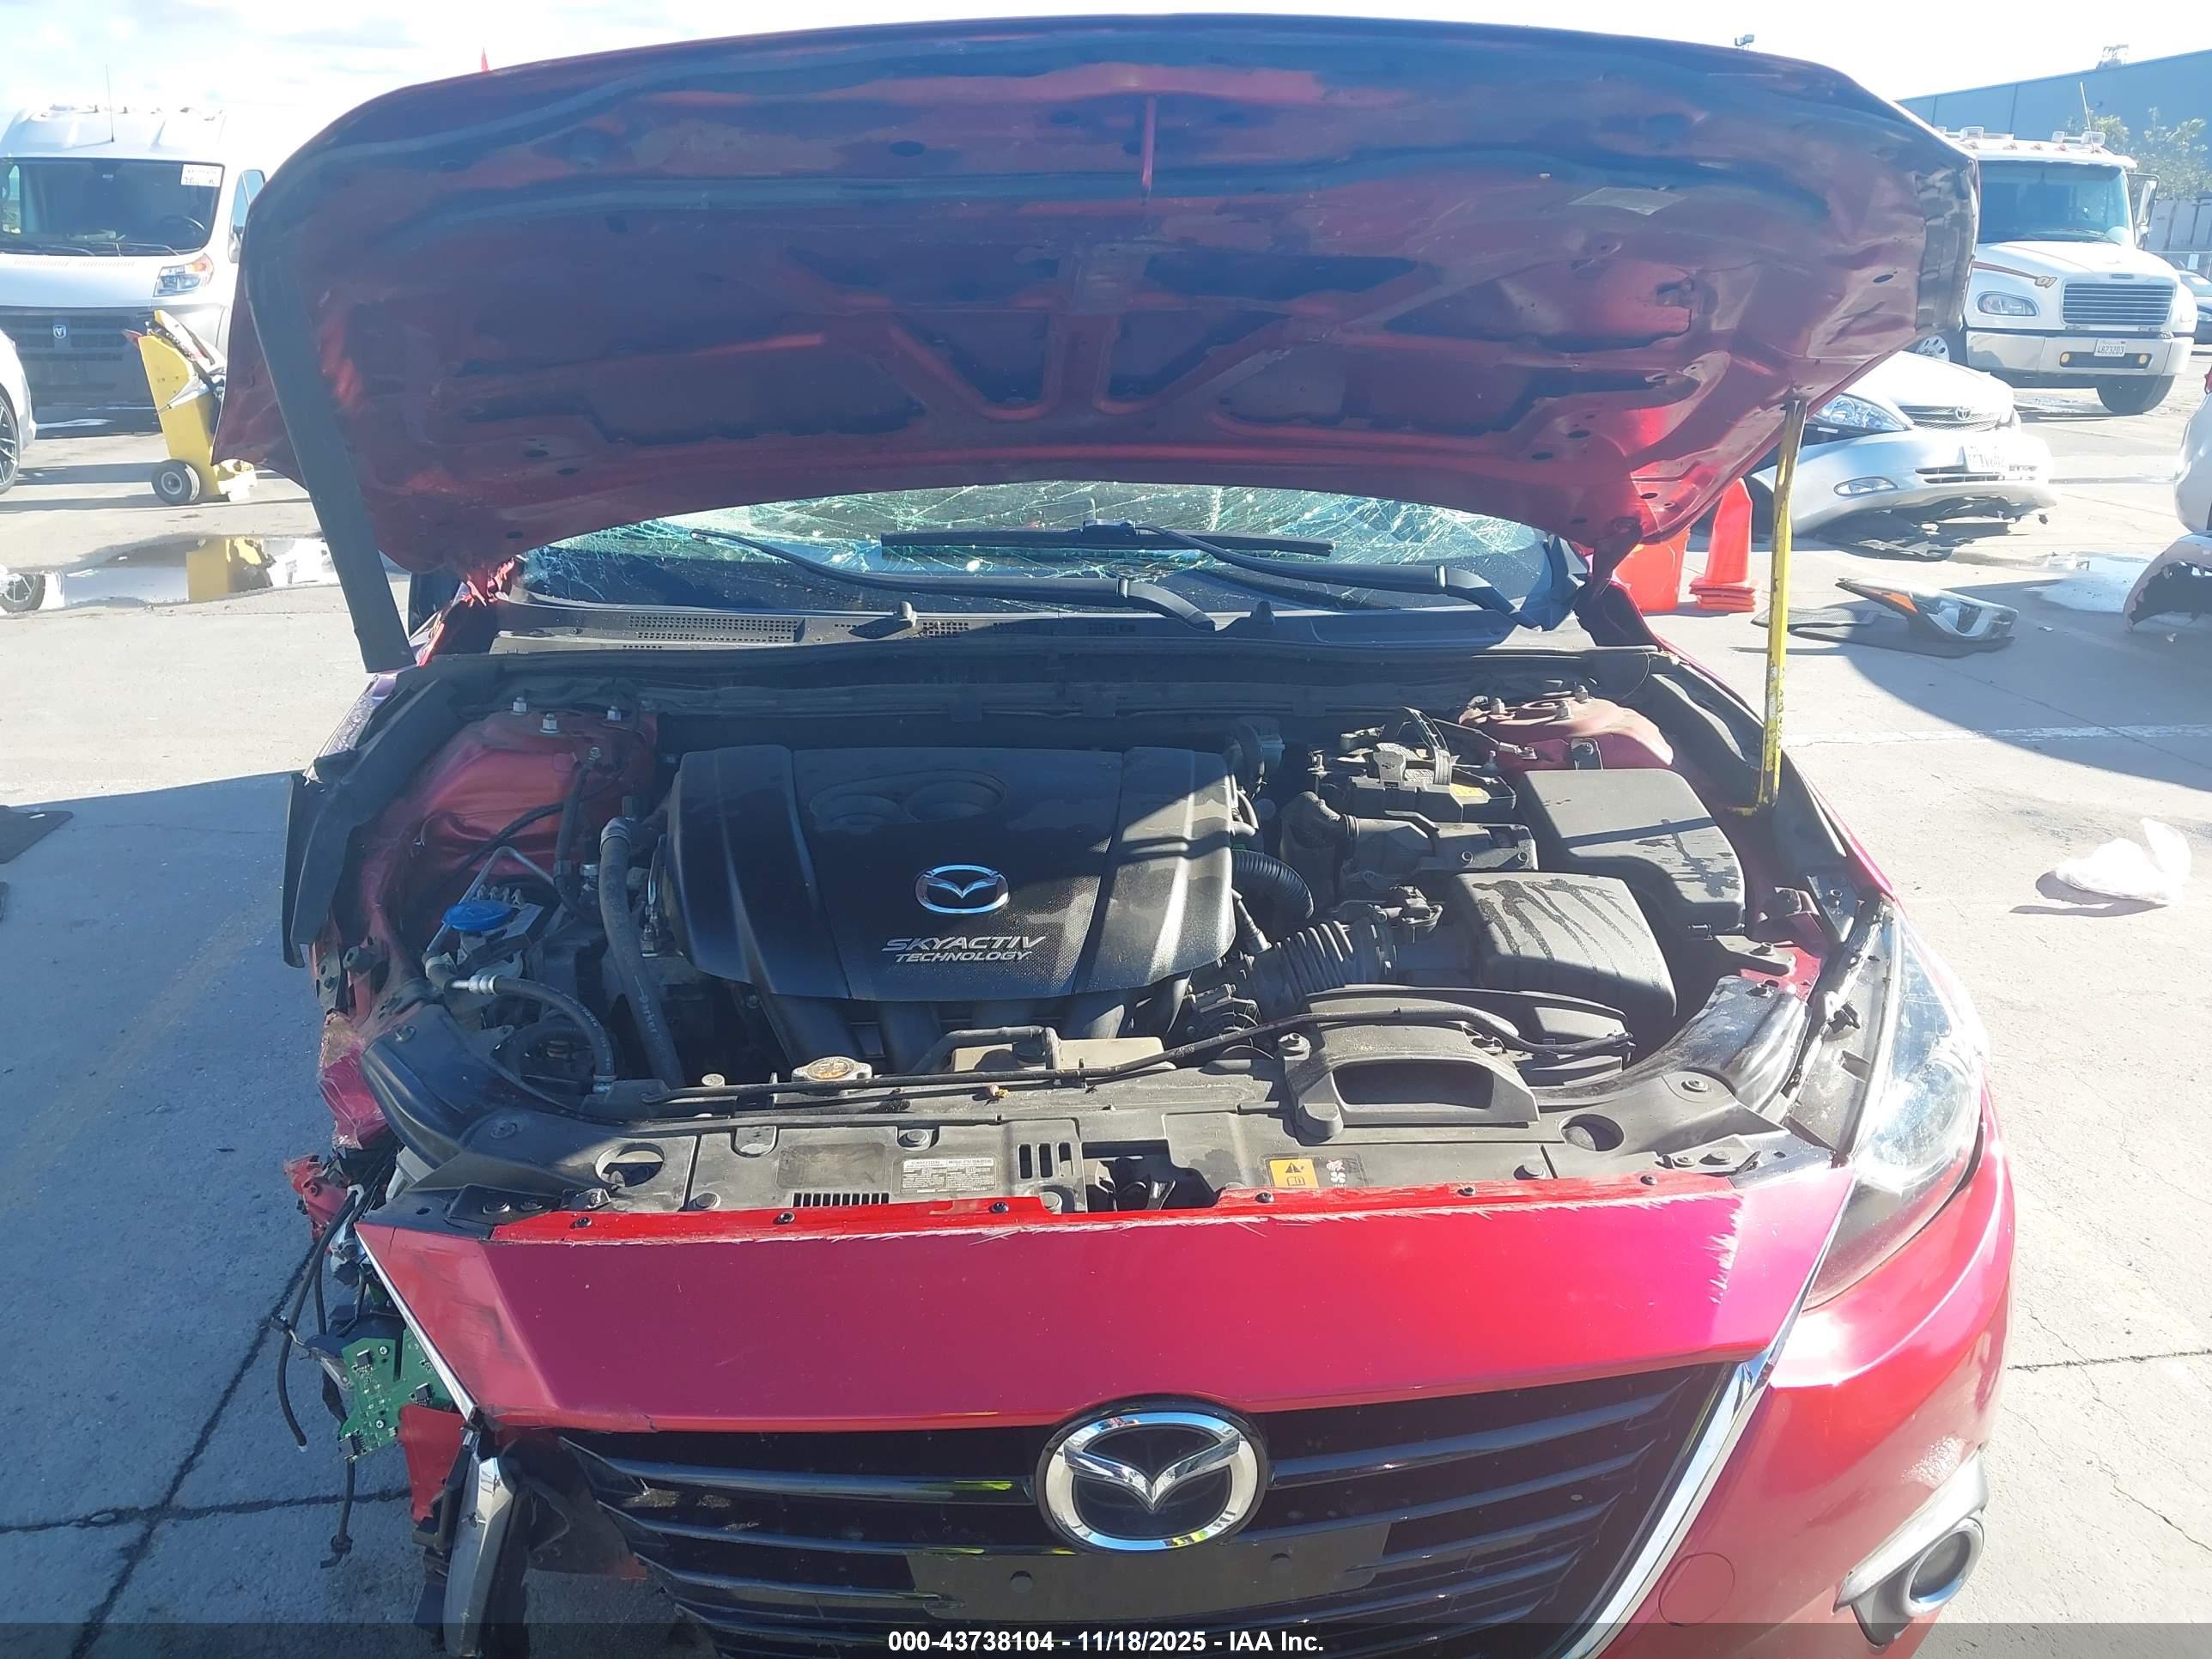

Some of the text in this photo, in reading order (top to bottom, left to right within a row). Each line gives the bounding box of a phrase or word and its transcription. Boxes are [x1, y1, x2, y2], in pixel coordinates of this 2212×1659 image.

[2034, 276, 2057, 288] 01
[881, 936, 1047, 951] SKYACTIV
[896, 951, 1033, 963] TECHNOLOGY
